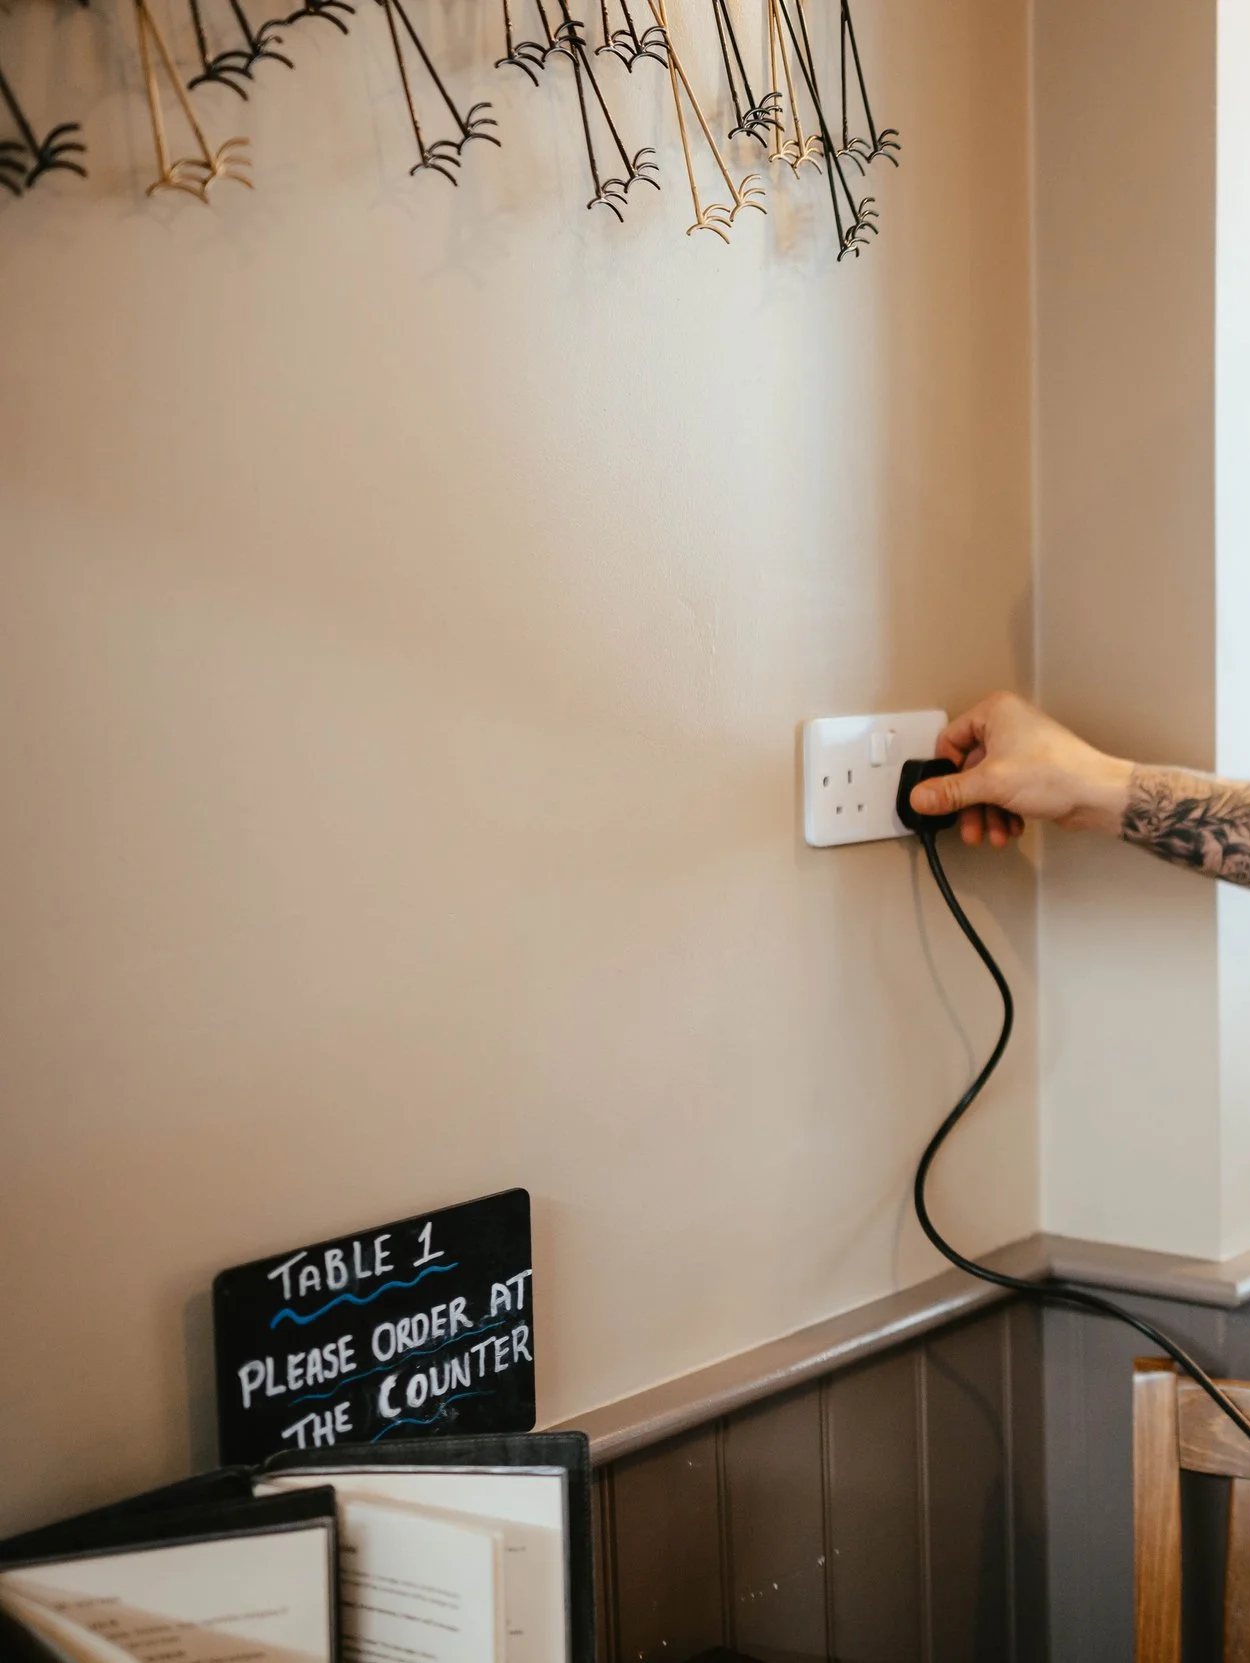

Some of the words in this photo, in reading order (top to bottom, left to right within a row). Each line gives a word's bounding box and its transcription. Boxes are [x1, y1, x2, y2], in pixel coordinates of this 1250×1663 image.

[267, 1233, 395, 1300] TABLE
[412, 1221, 445, 1267] 1
[237, 1334, 358, 1409] PLEASE
[371, 1296, 474, 1362] ORDER
[489, 1268, 533, 1318] AT
[281, 1401, 354, 1450] THE
[377, 1324, 534, 1419] COUNTER
